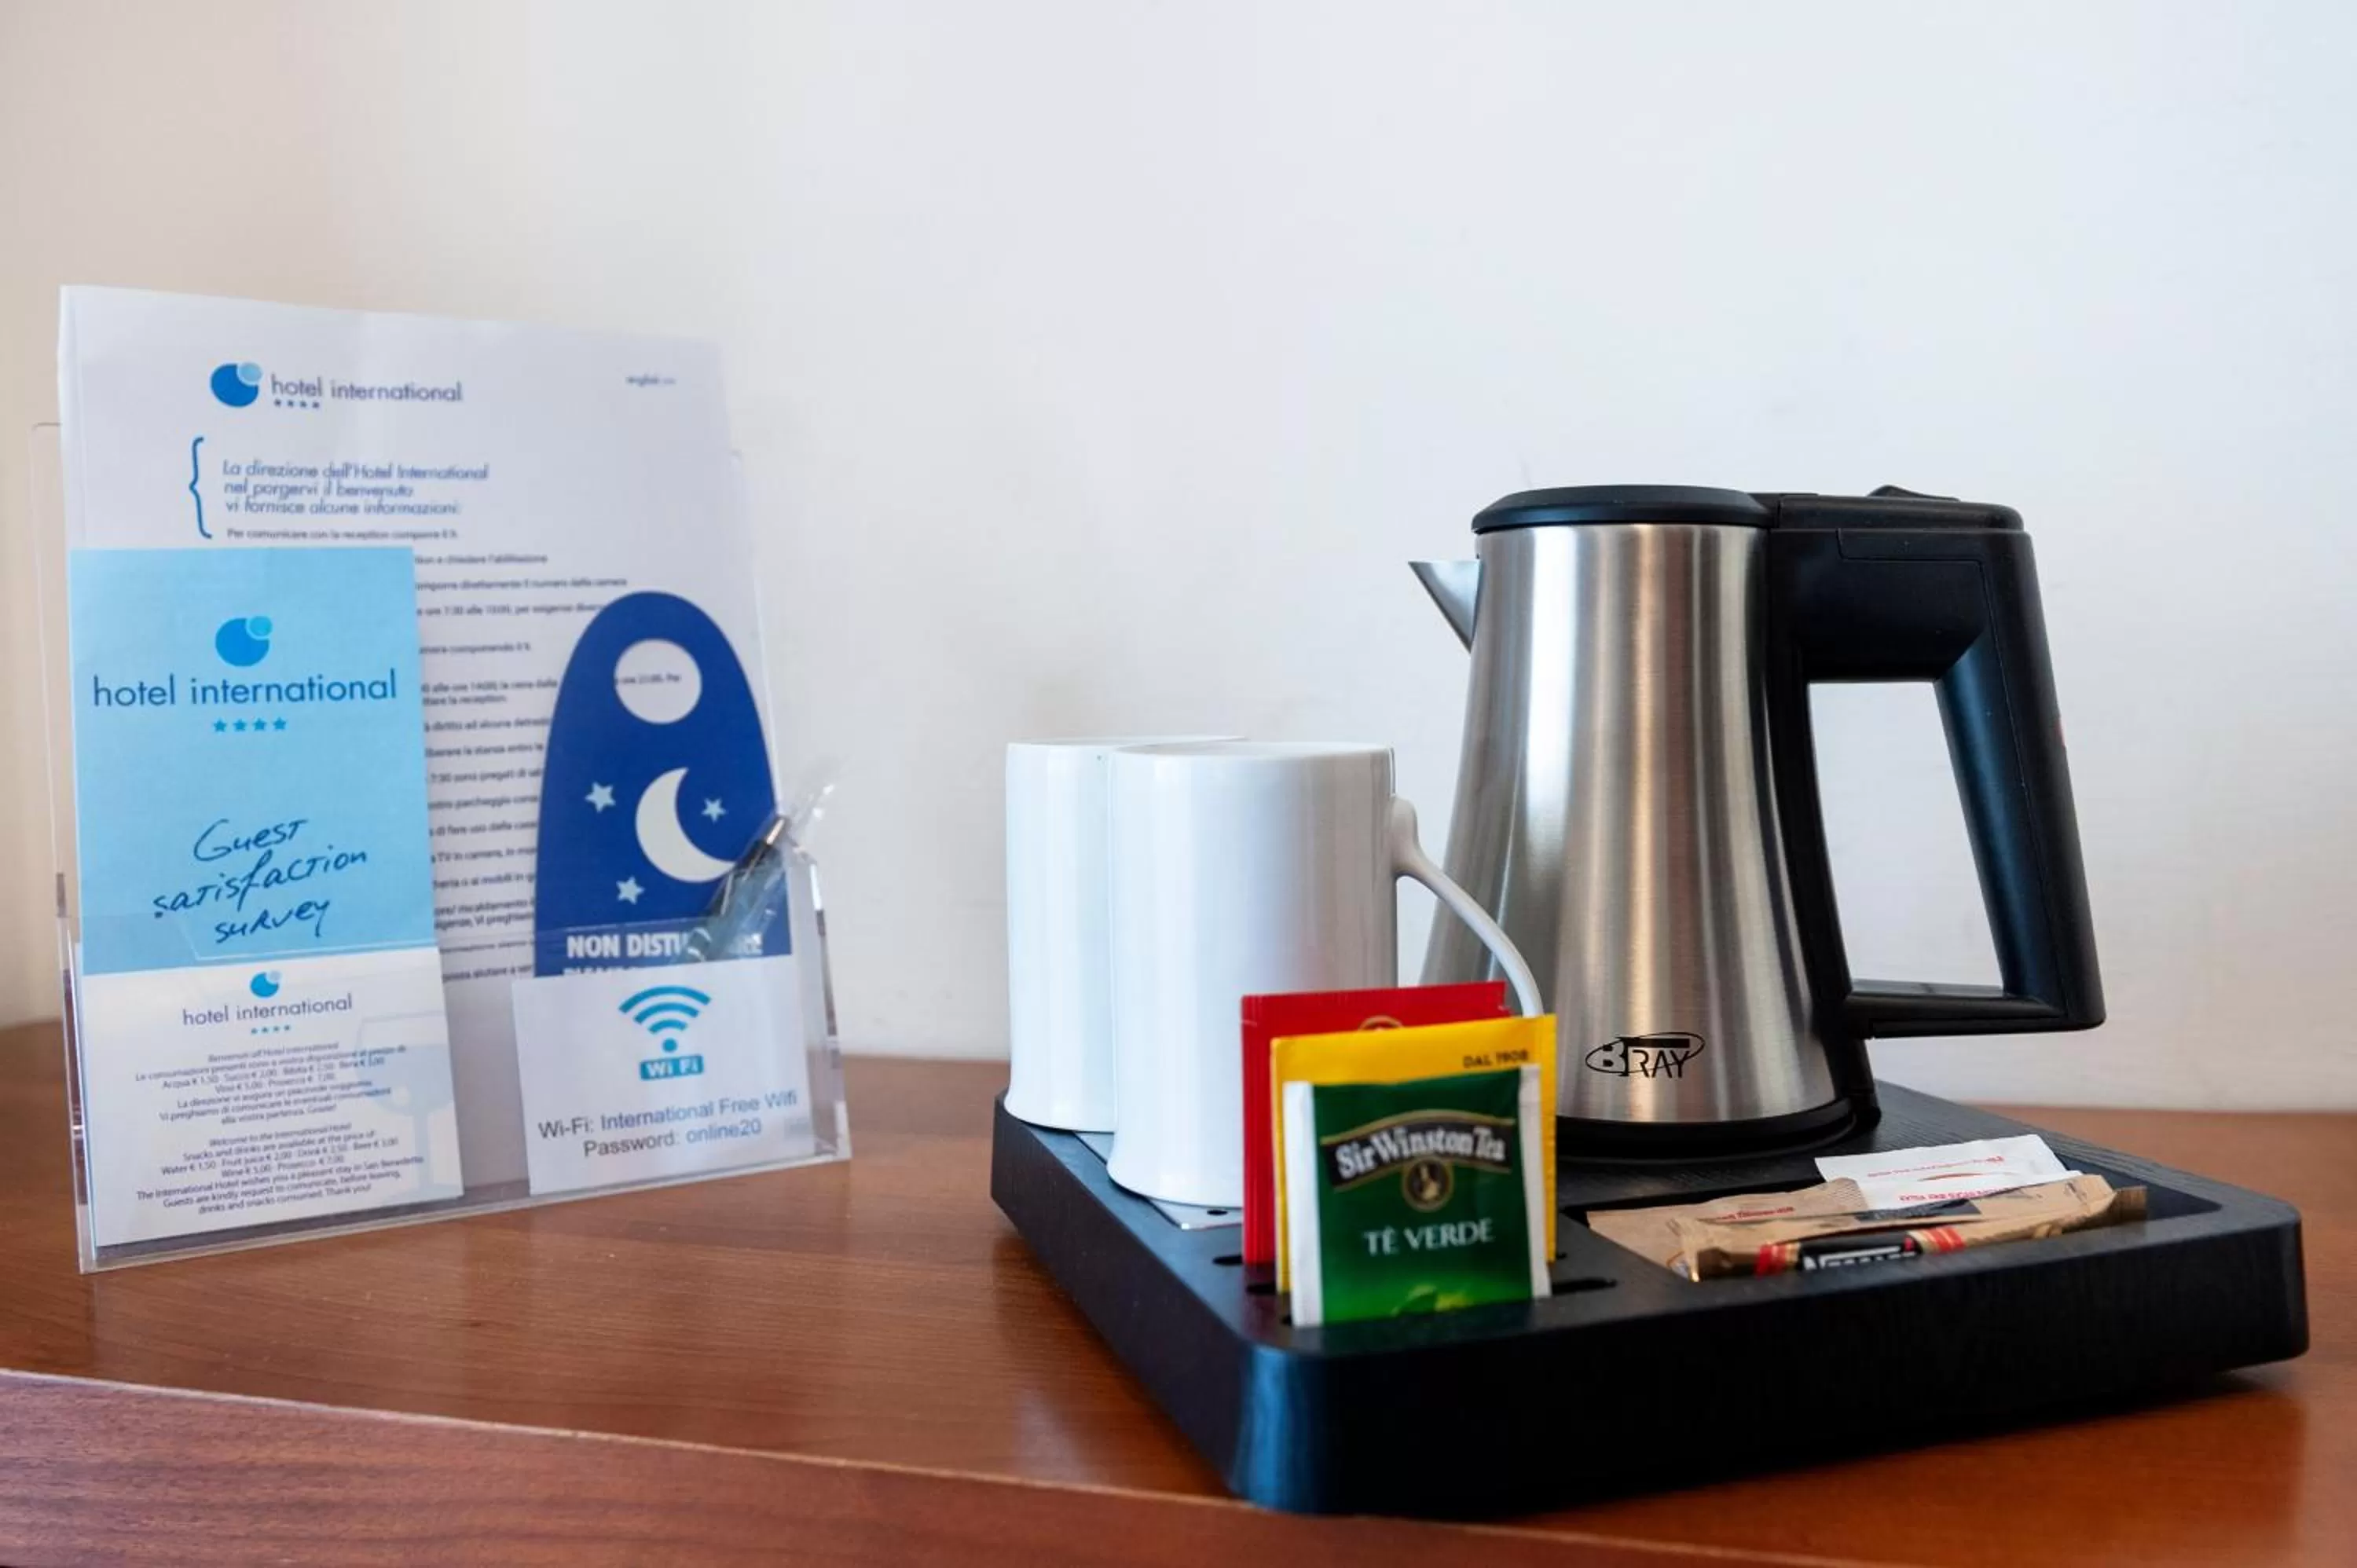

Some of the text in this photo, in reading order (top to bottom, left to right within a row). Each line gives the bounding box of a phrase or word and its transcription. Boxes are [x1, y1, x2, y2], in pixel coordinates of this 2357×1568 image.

[270, 373, 463, 401] hotel international
[222, 460, 489, 480] La direzione dell'Hotel International
[225, 478, 247, 493] nel
[253, 481, 317, 500] porgervi
[336, 482, 413, 497] benvenuto
[225, 499, 238, 513] vi
[244, 496, 305, 514] fornisce
[310, 496, 359, 514] alcune
[93, 667, 398, 707] hotel international
[192, 817, 309, 863] Guest
[152, 848, 367, 918] satisfaction
[214, 899, 331, 944] survey
[566, 934, 621, 958] NON
[181, 992, 353, 1026] hotel international
[1464, 1054, 1490, 1068] DAL
[538, 1090, 797, 1139] Wi-Fi: International Free Wifi
[584, 1119, 762, 1158] Password: online20
[1336, 1126, 1506, 1179] Sir Winston Tea
[1403, 1218, 1495, 1251] VERDE
